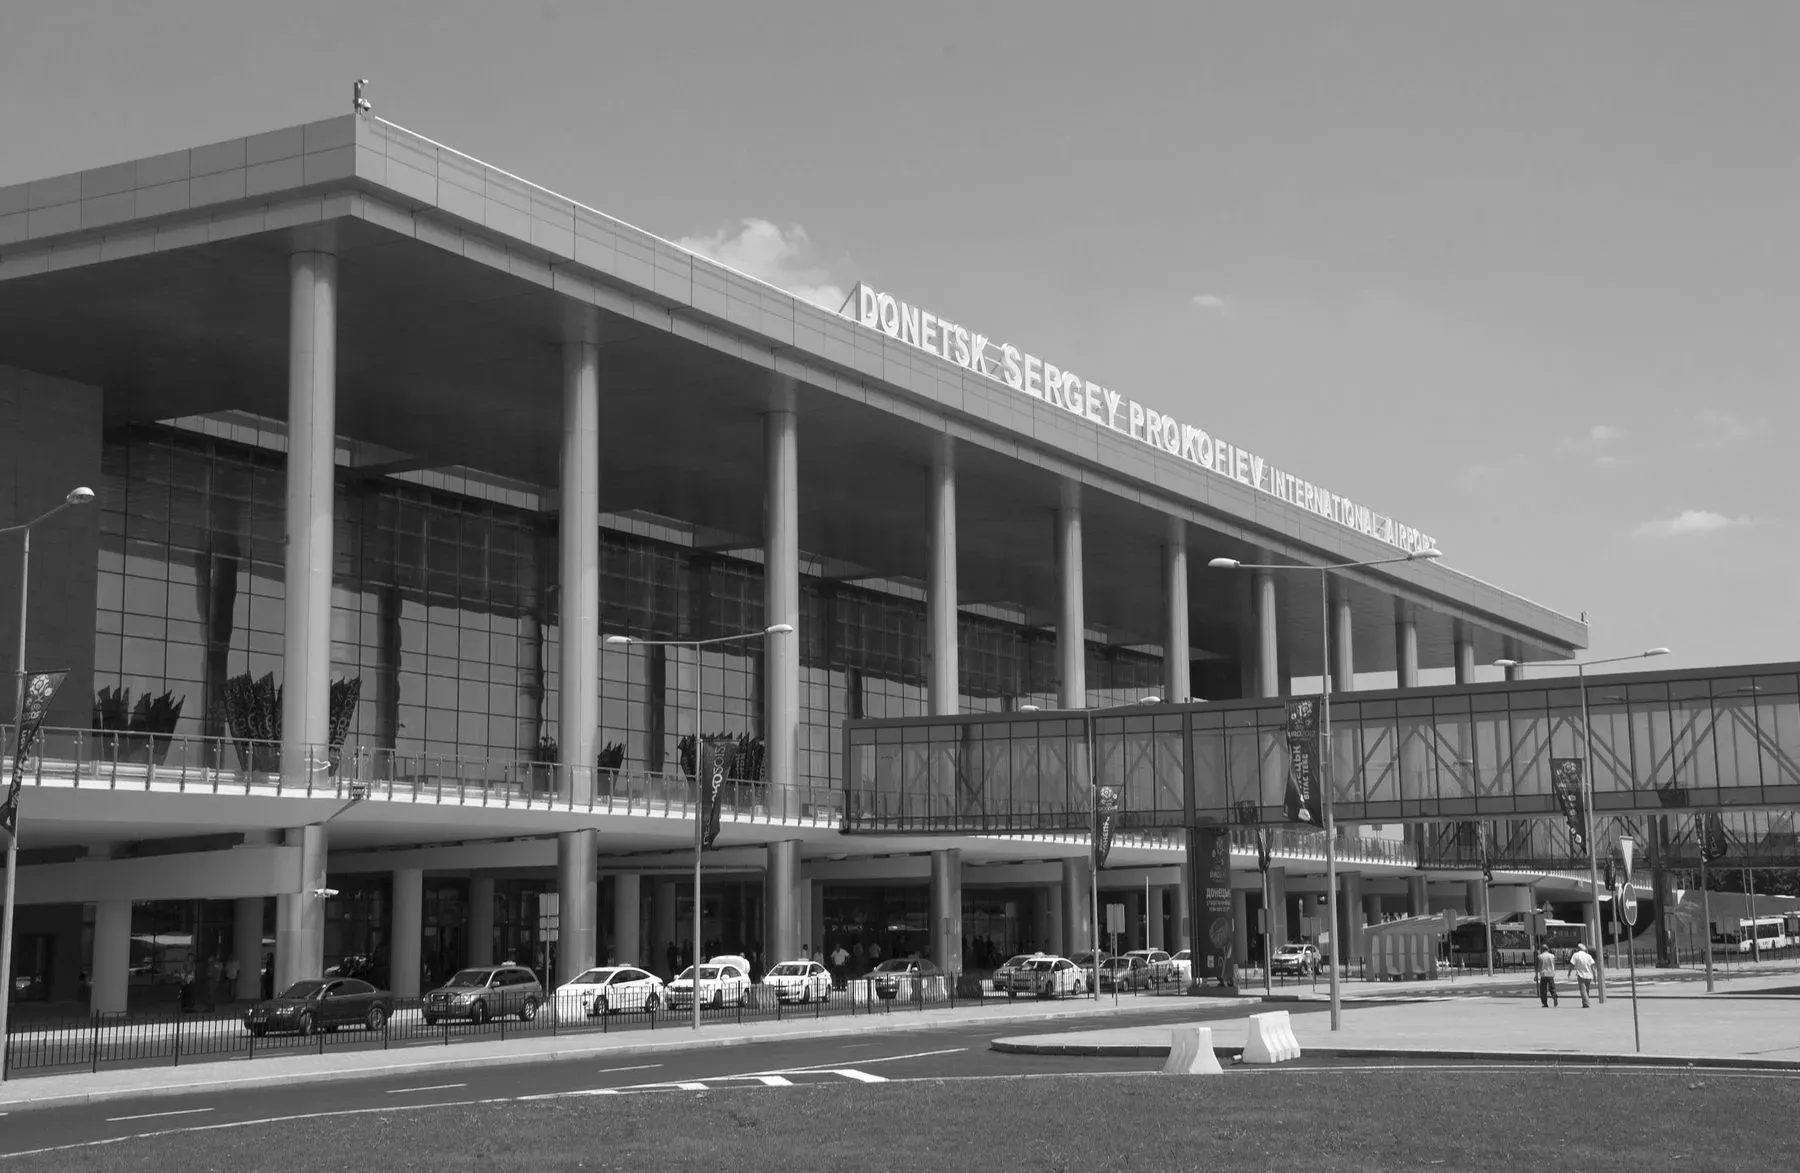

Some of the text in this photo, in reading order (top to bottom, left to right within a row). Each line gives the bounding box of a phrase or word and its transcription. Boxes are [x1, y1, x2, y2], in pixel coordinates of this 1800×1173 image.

[857, 281, 1437, 552] DONETSK SERGEY PROKOFIEV INTERNATIONAL AIRPORT
